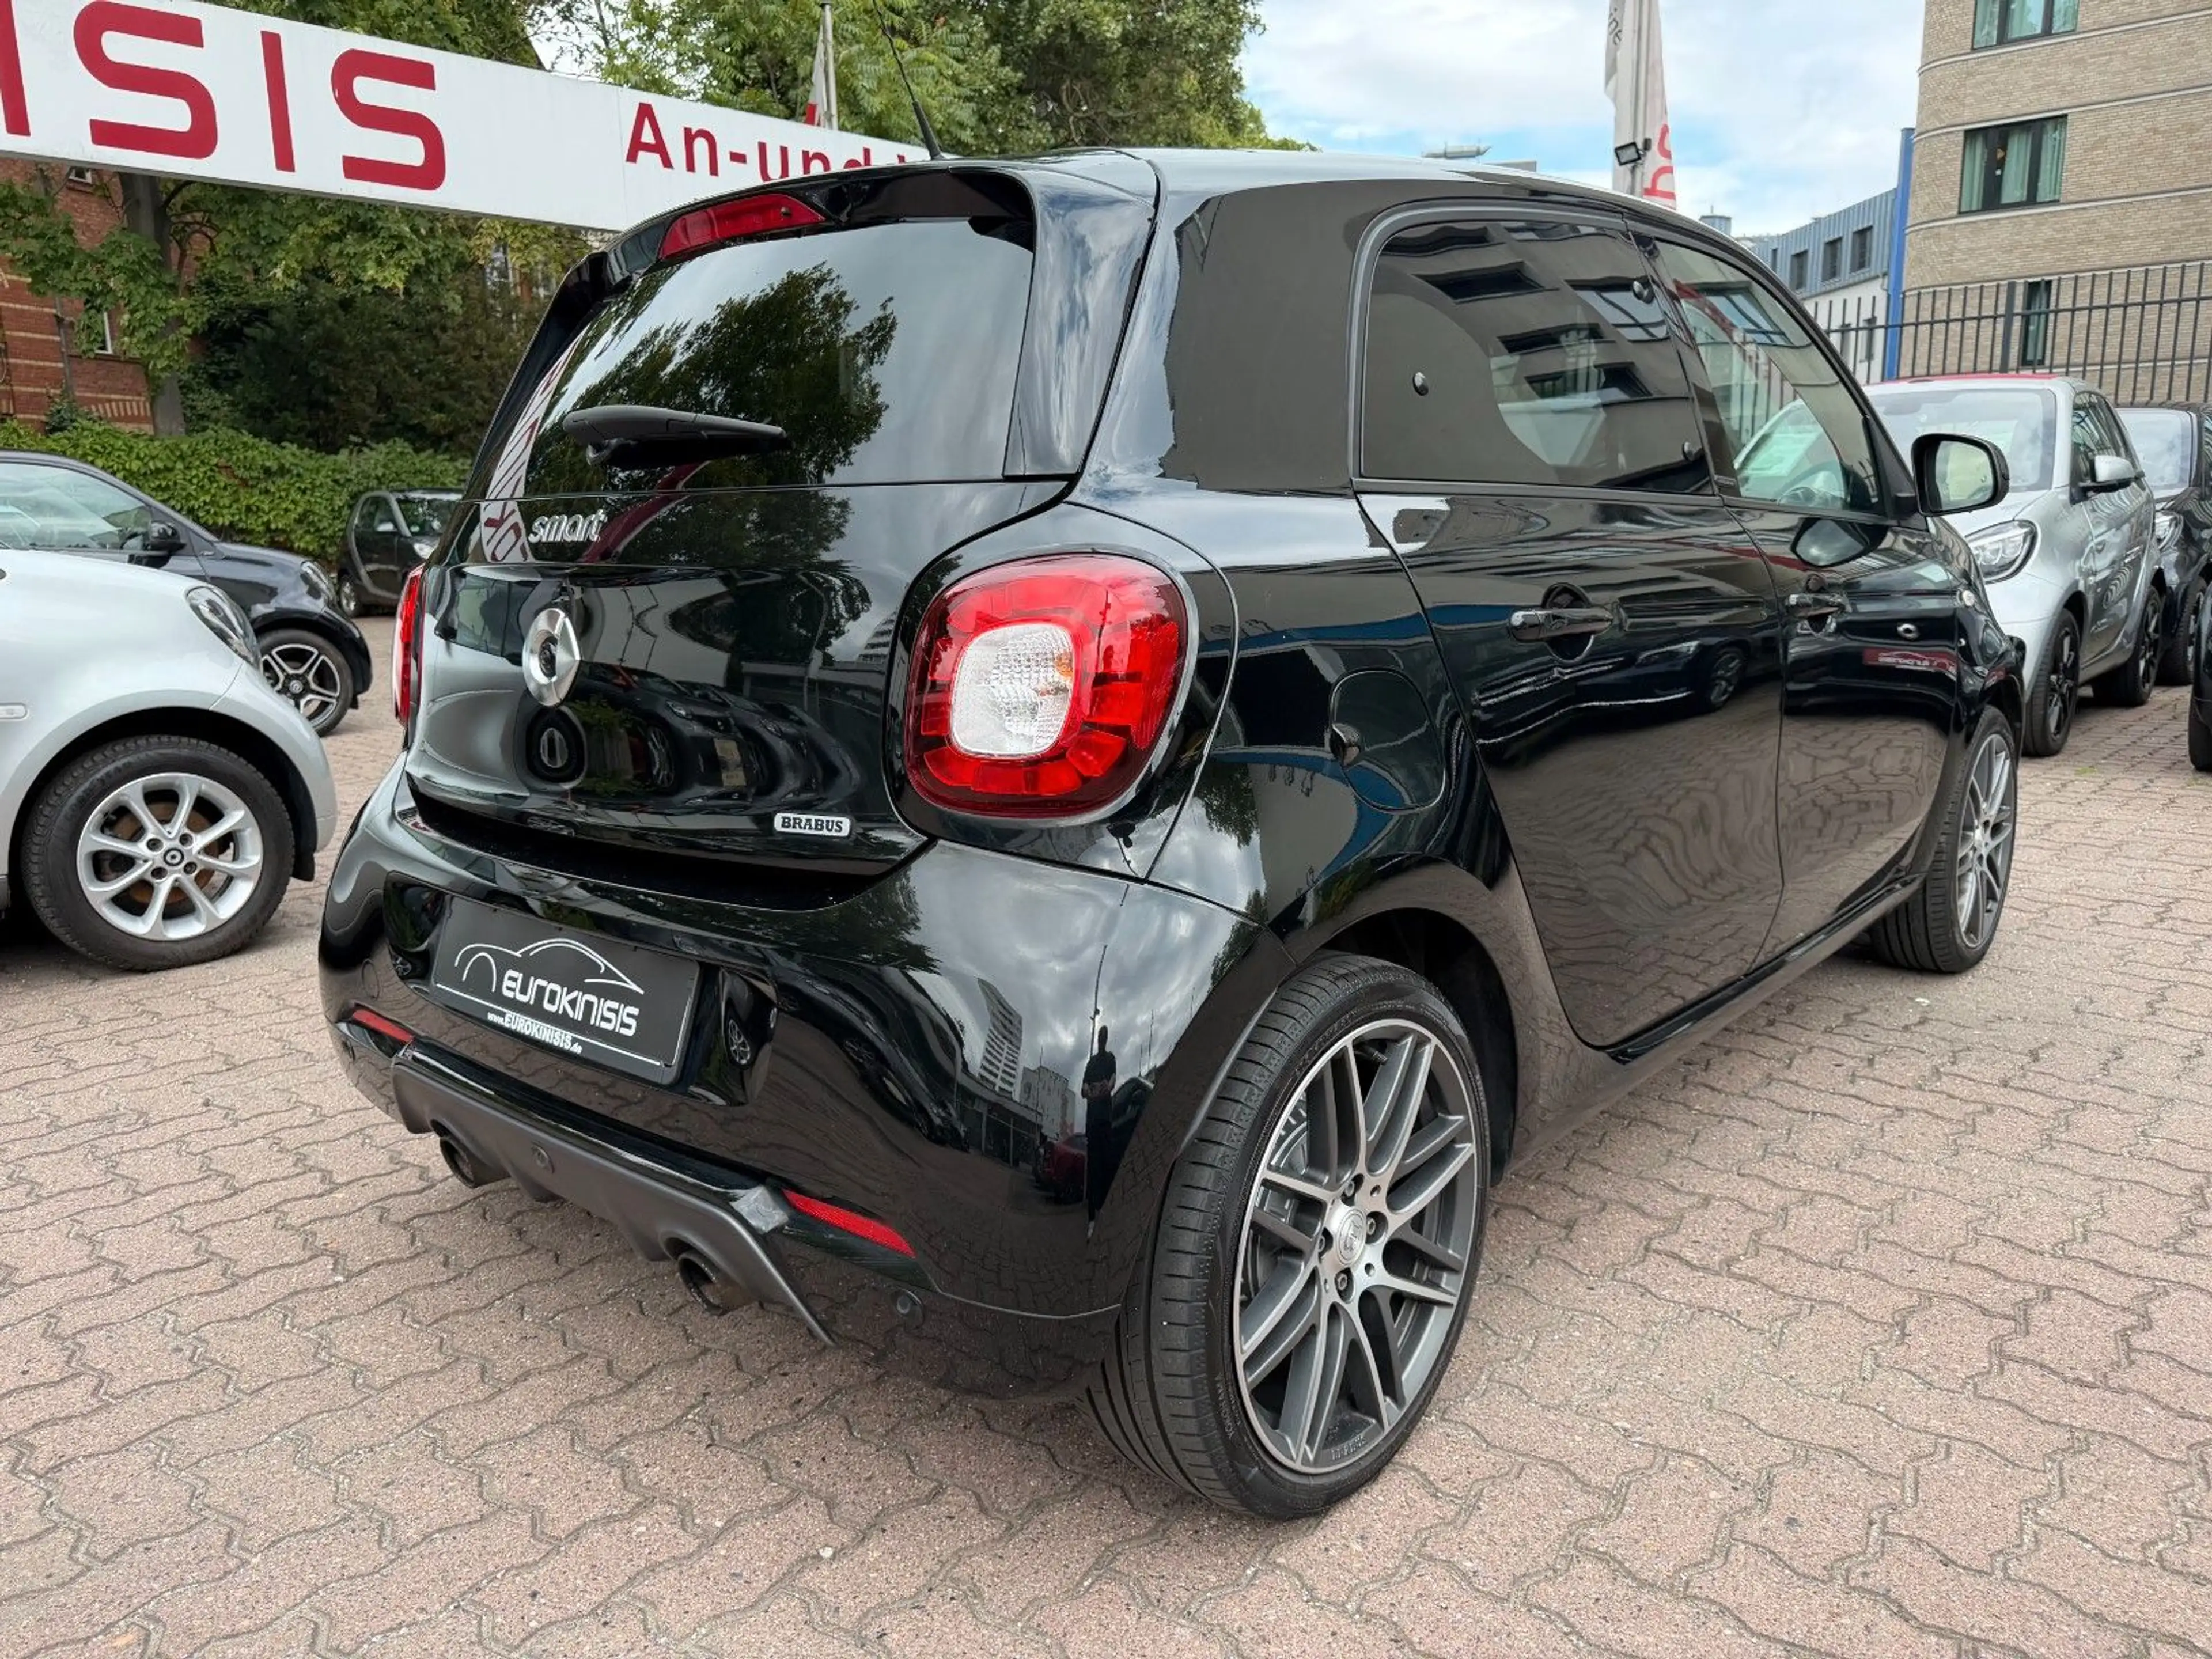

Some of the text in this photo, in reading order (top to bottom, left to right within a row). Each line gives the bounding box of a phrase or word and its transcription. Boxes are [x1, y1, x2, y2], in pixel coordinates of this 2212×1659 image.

[528, 509, 607, 543] smart
[781, 816, 843, 833] BRABUS
[487, 1012, 583, 1054] www.EUROKINISIS.de
